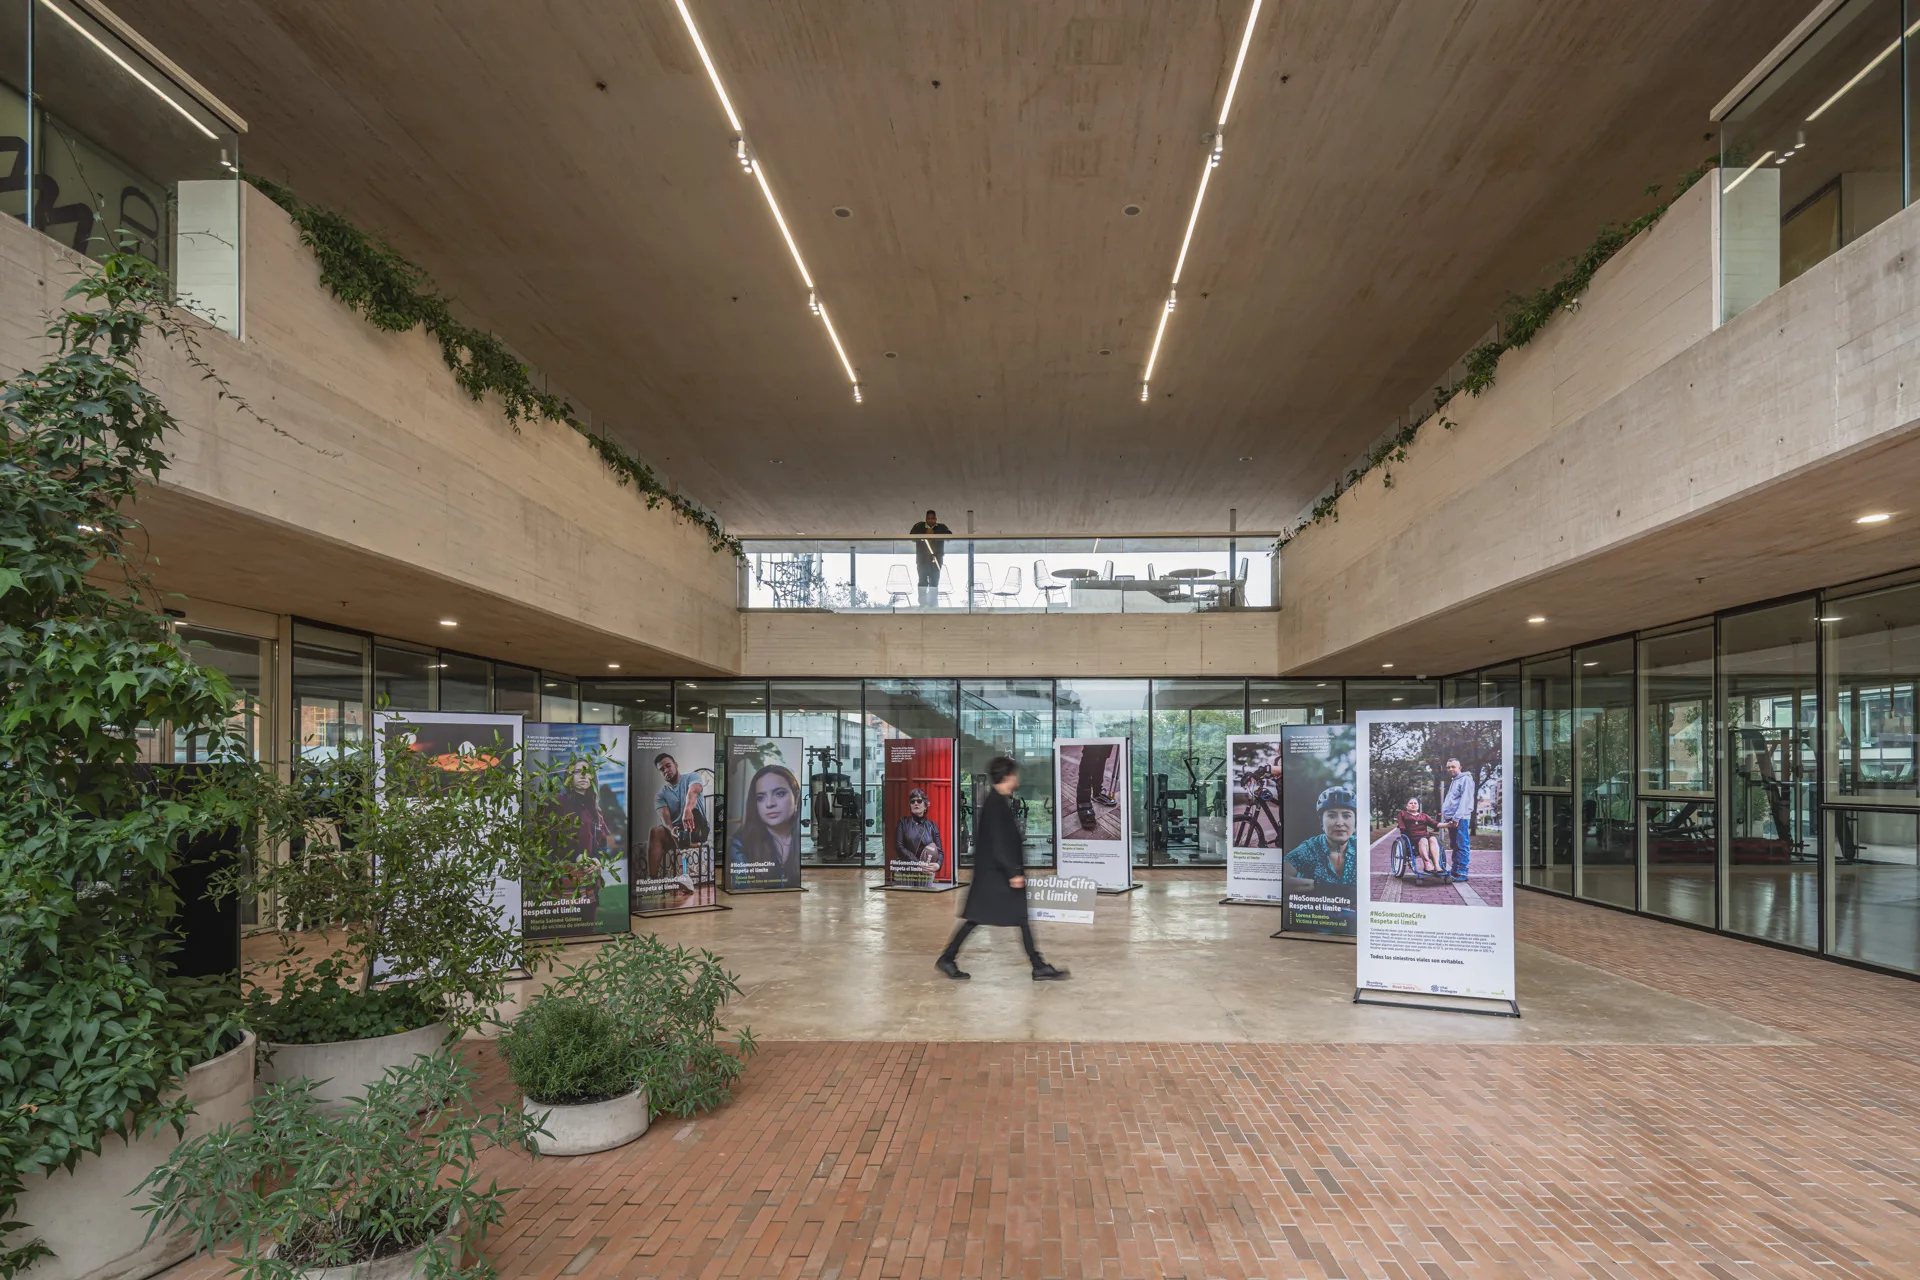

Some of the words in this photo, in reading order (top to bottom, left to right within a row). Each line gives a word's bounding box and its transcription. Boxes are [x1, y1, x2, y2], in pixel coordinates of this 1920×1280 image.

[1025, 877, 1095, 889] mosUnaCifra
[1034, 890, 1044, 900] el
[1047, 890, 1078, 902] límite
[1289, 894, 1350, 904] #NoSomosUnaCifra
[1289, 902, 1314, 910] Respeta
[523, 908, 551, 917] Respeta
[1370, 910, 1427, 919] #NoSomosUnaCifra
